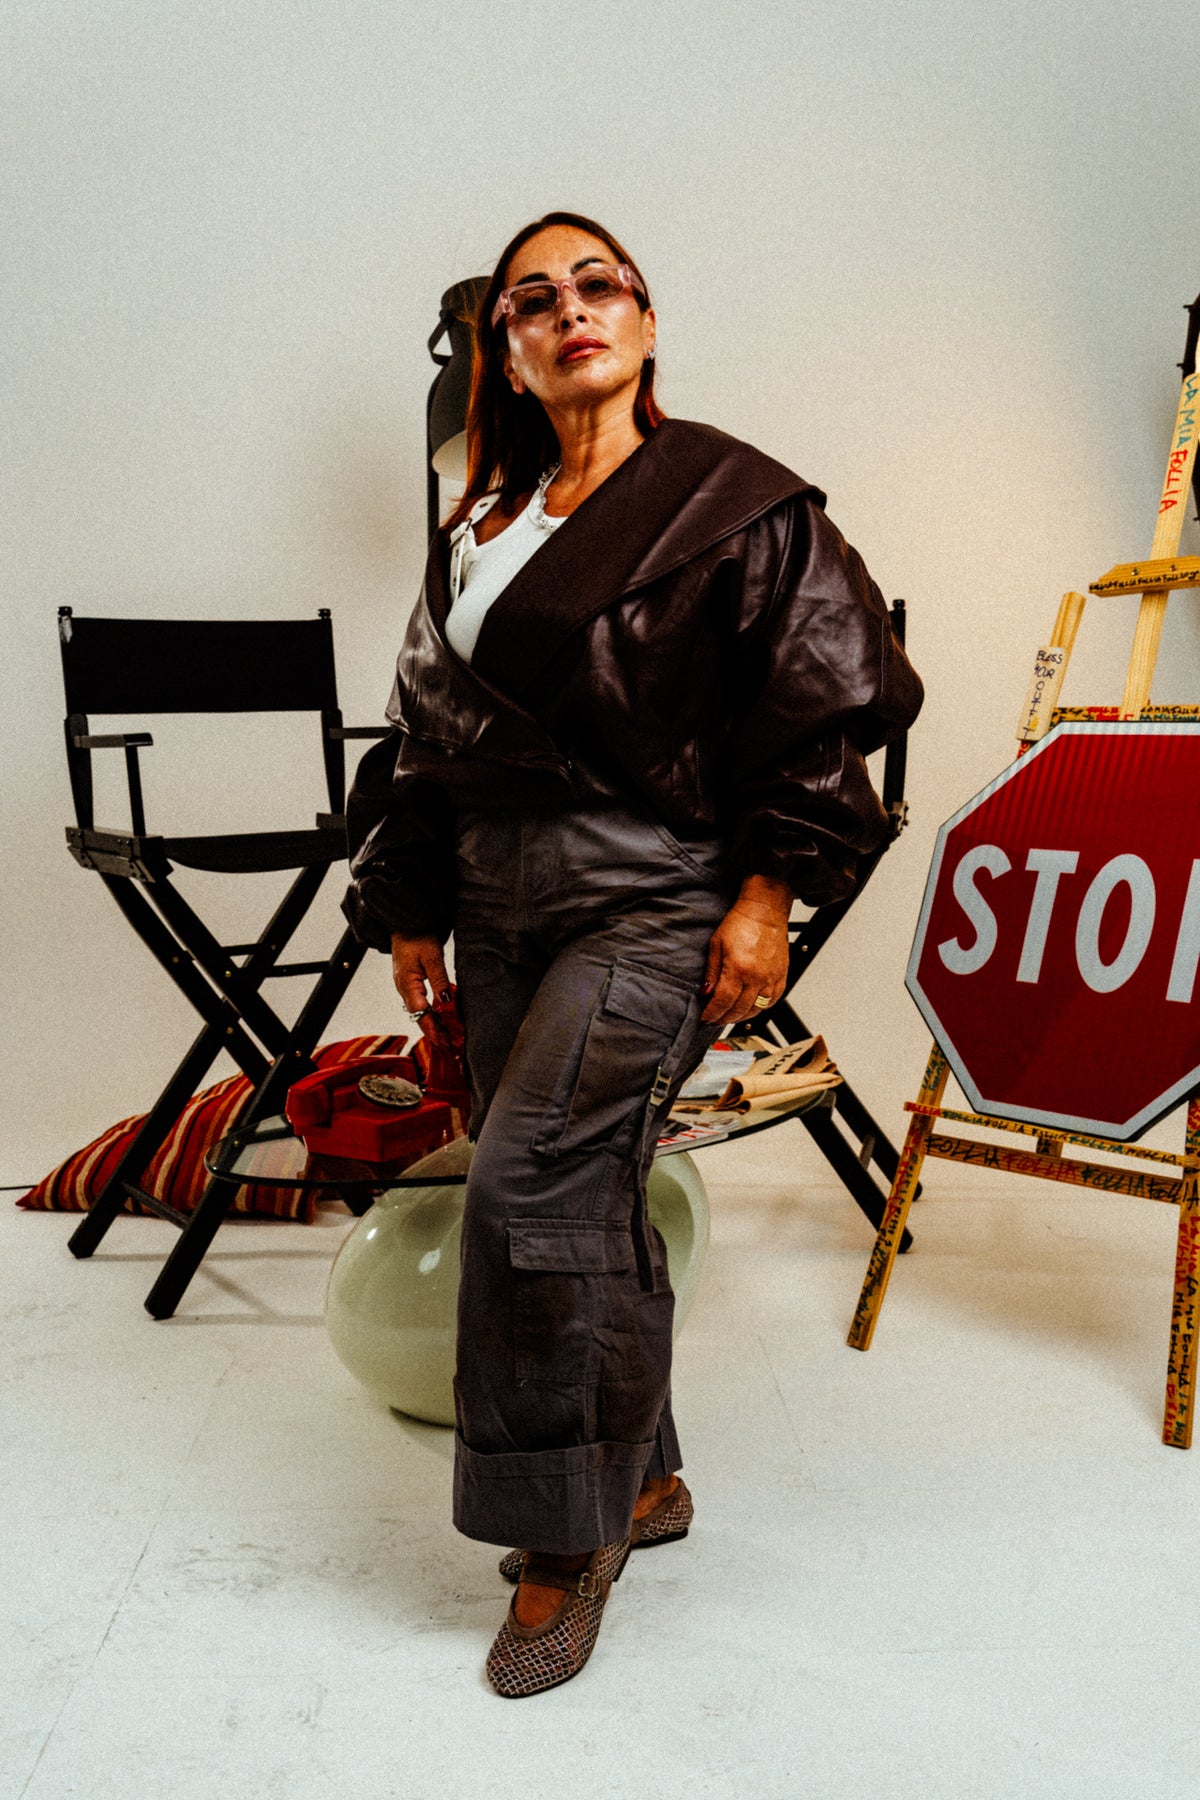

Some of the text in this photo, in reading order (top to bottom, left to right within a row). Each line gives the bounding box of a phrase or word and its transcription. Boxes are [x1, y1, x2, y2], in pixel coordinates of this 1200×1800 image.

[1158, 375, 1199, 514] LA MIA FOLLIA
[1036, 650, 1063, 664] BLESS
[924, 1134, 1001, 1169] FOLLIA
[1081, 1163, 1146, 1198] FOLLIA
